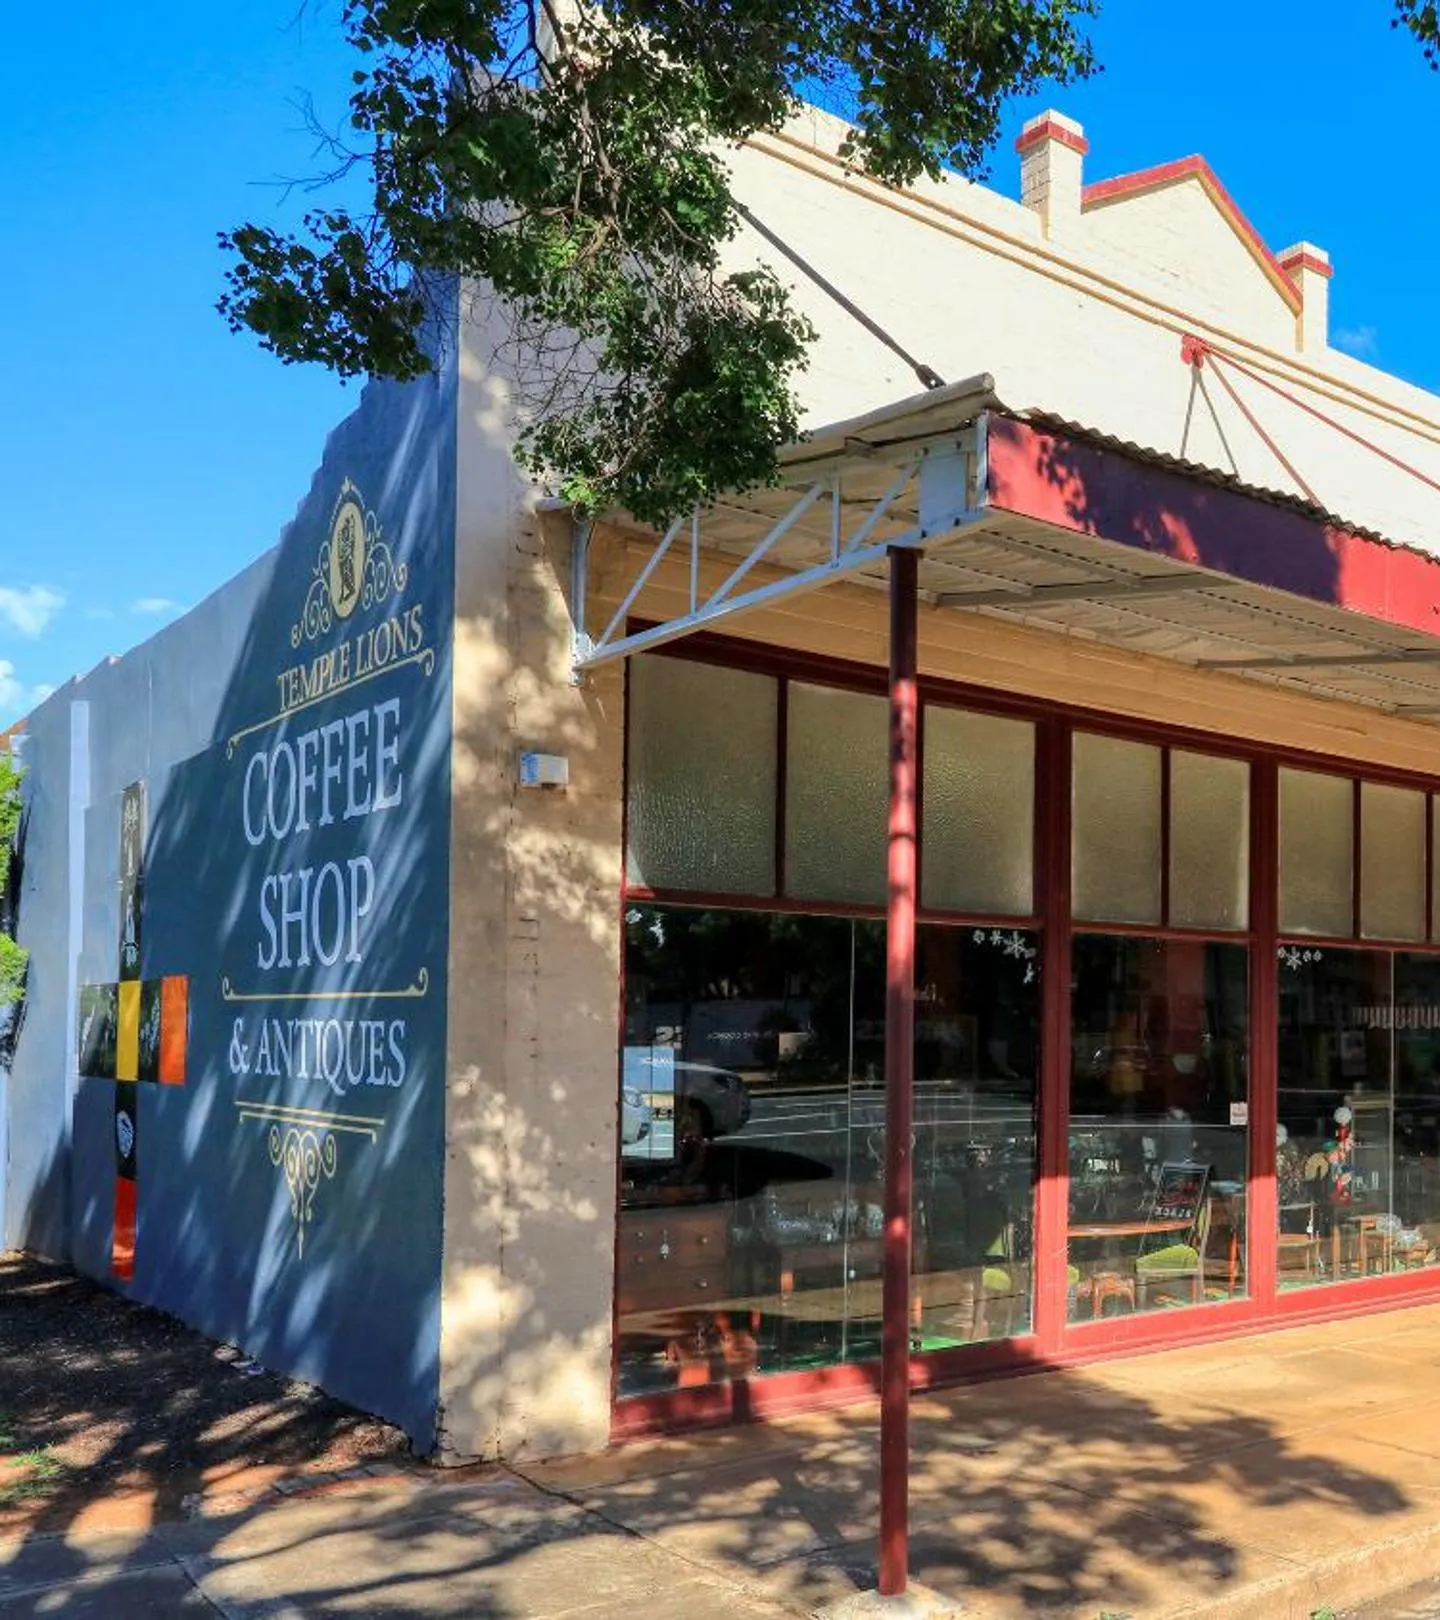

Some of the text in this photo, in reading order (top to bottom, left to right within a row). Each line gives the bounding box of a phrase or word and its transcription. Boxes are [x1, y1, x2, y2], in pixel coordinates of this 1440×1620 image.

[276, 604, 423, 711] TEMPLE LIONS
[243, 697, 402, 845] COFFEE
[258, 856, 375, 970] SHOP
[229, 1017, 406, 1095] & ANTIQUES
